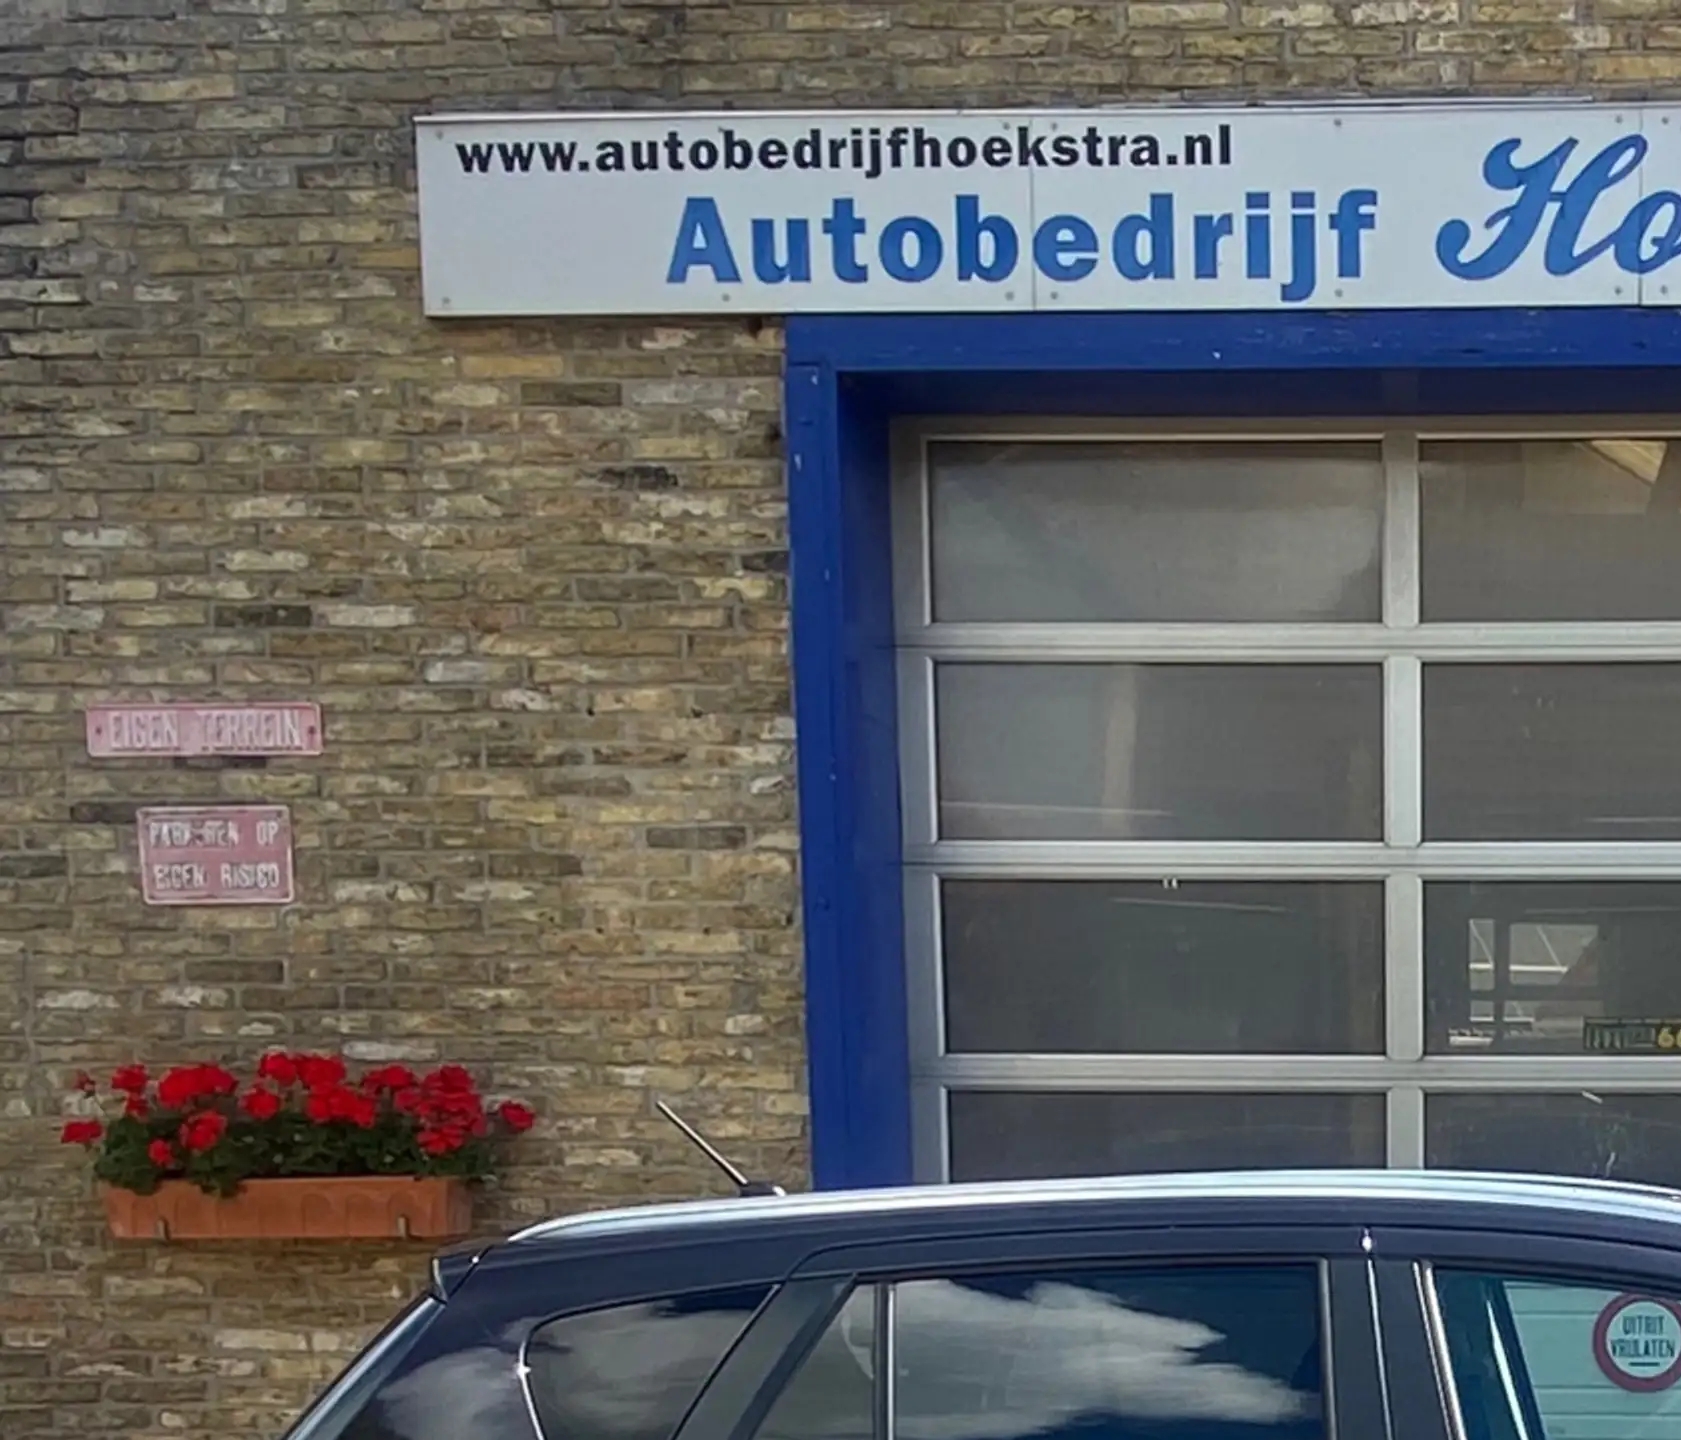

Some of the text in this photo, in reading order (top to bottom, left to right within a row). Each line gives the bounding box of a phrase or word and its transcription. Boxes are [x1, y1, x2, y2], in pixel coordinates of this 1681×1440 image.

[455, 123, 1232, 178] www.autobedrijfhoekstra.nl
[664, 188, 1377, 302] Autobedrijf
[108, 711, 178, 748] EIGEN
[256, 820, 279, 845] OP
